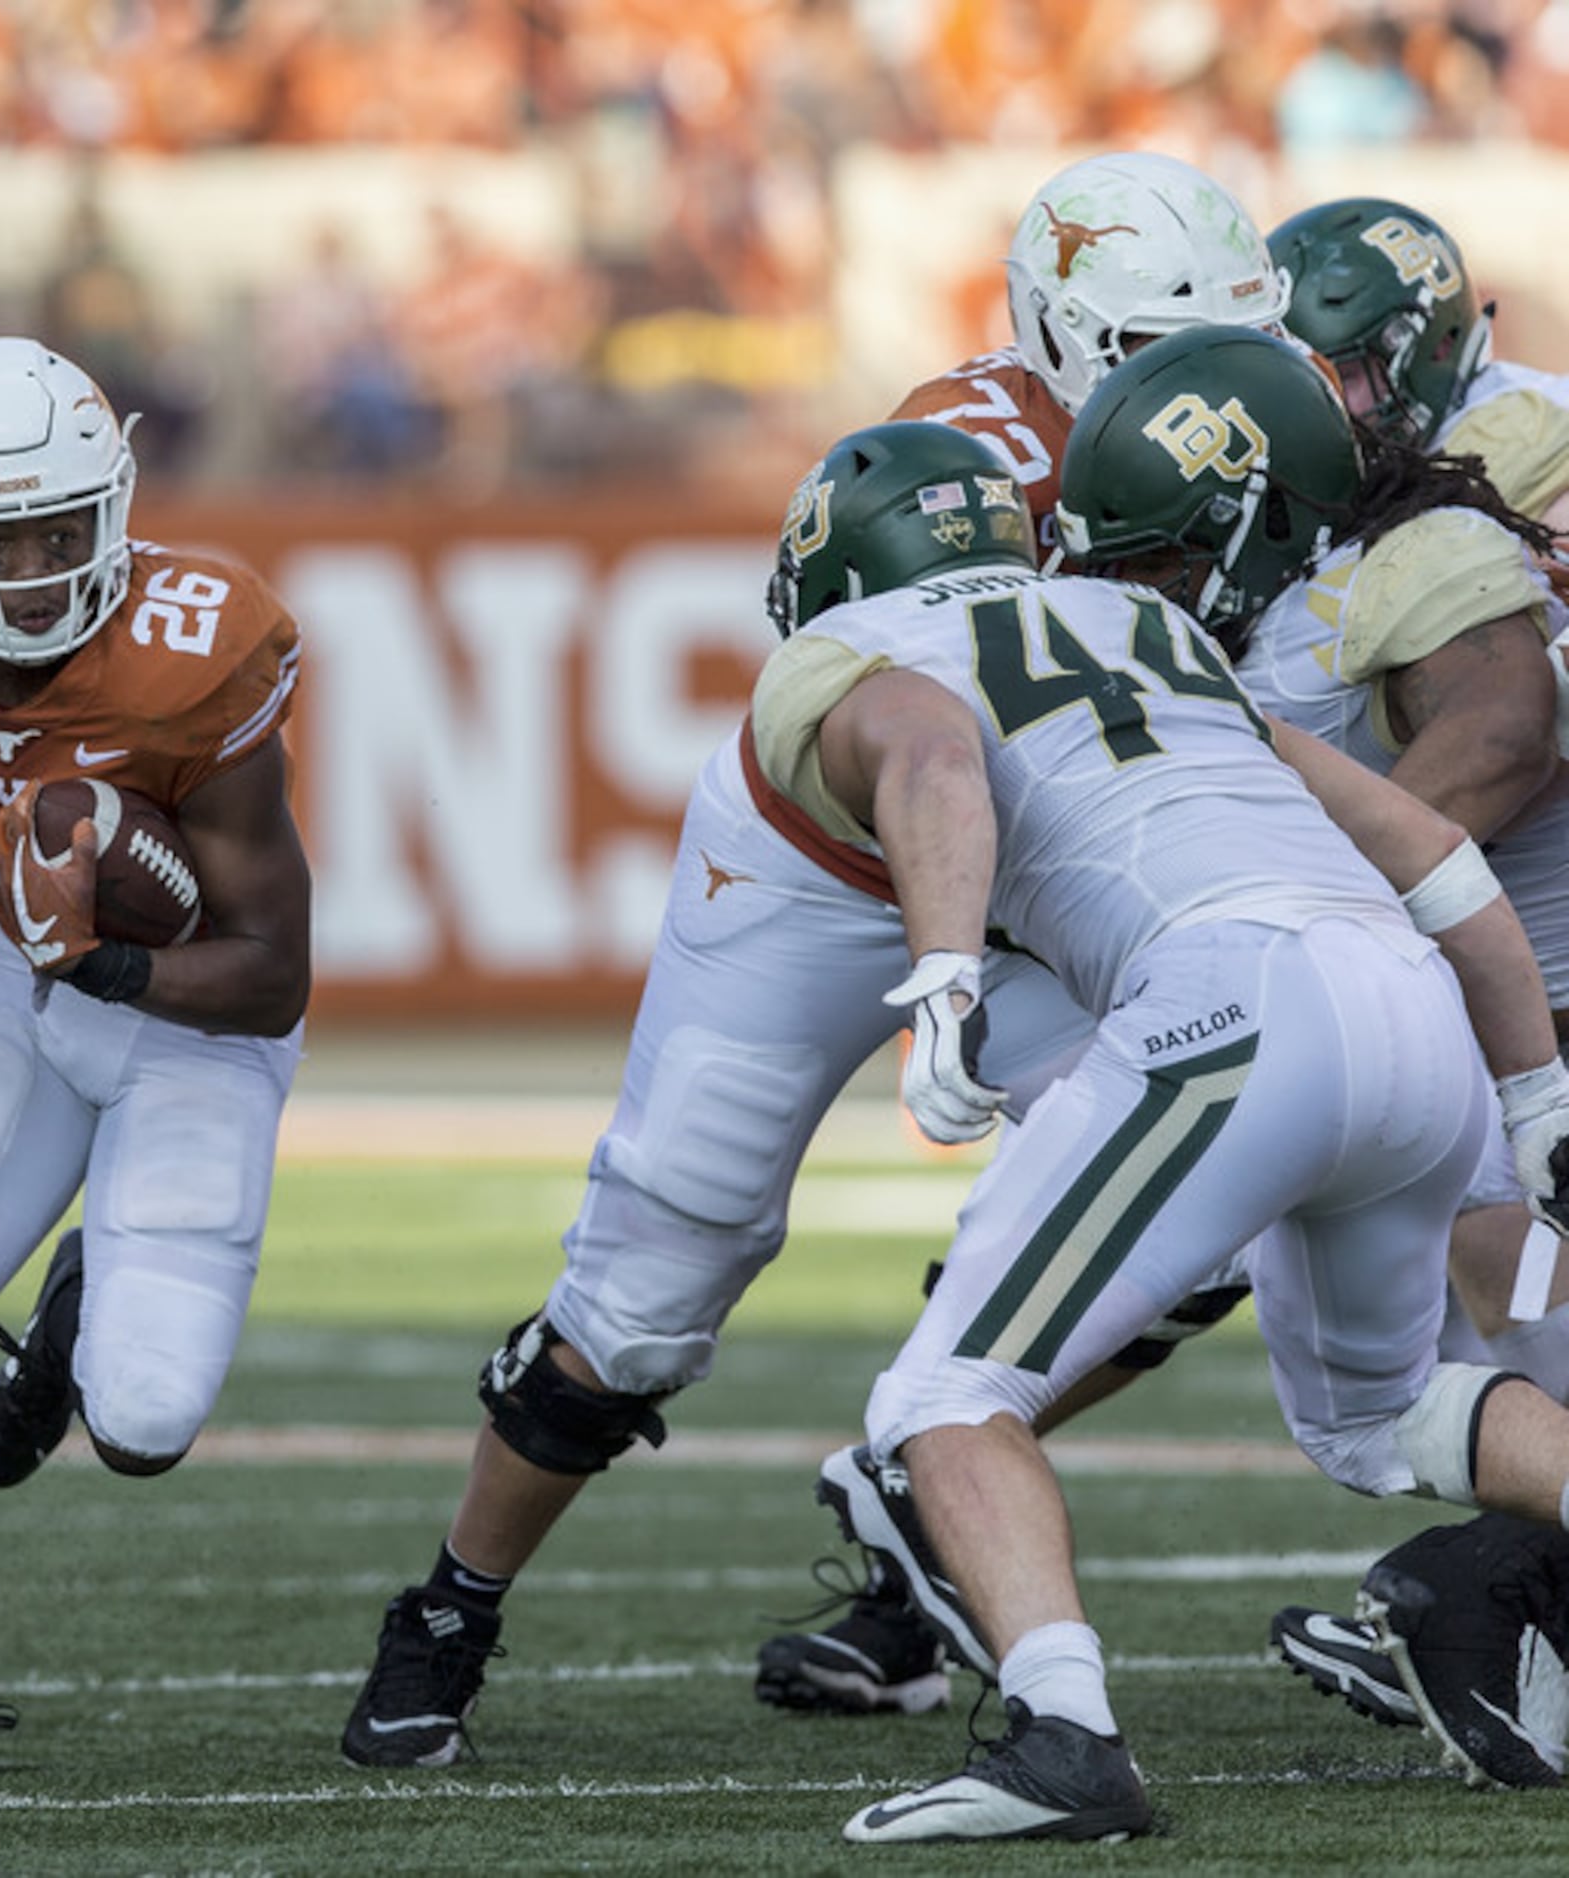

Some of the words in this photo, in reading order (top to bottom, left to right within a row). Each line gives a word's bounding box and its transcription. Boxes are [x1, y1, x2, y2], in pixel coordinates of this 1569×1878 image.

[1359, 216, 1463, 301] BU
[1141, 393, 1271, 483] BU
[131, 566, 231, 657] 26
[966, 592, 1277, 770] 44
[1142, 1003, 1248, 1057] BAYLOR
